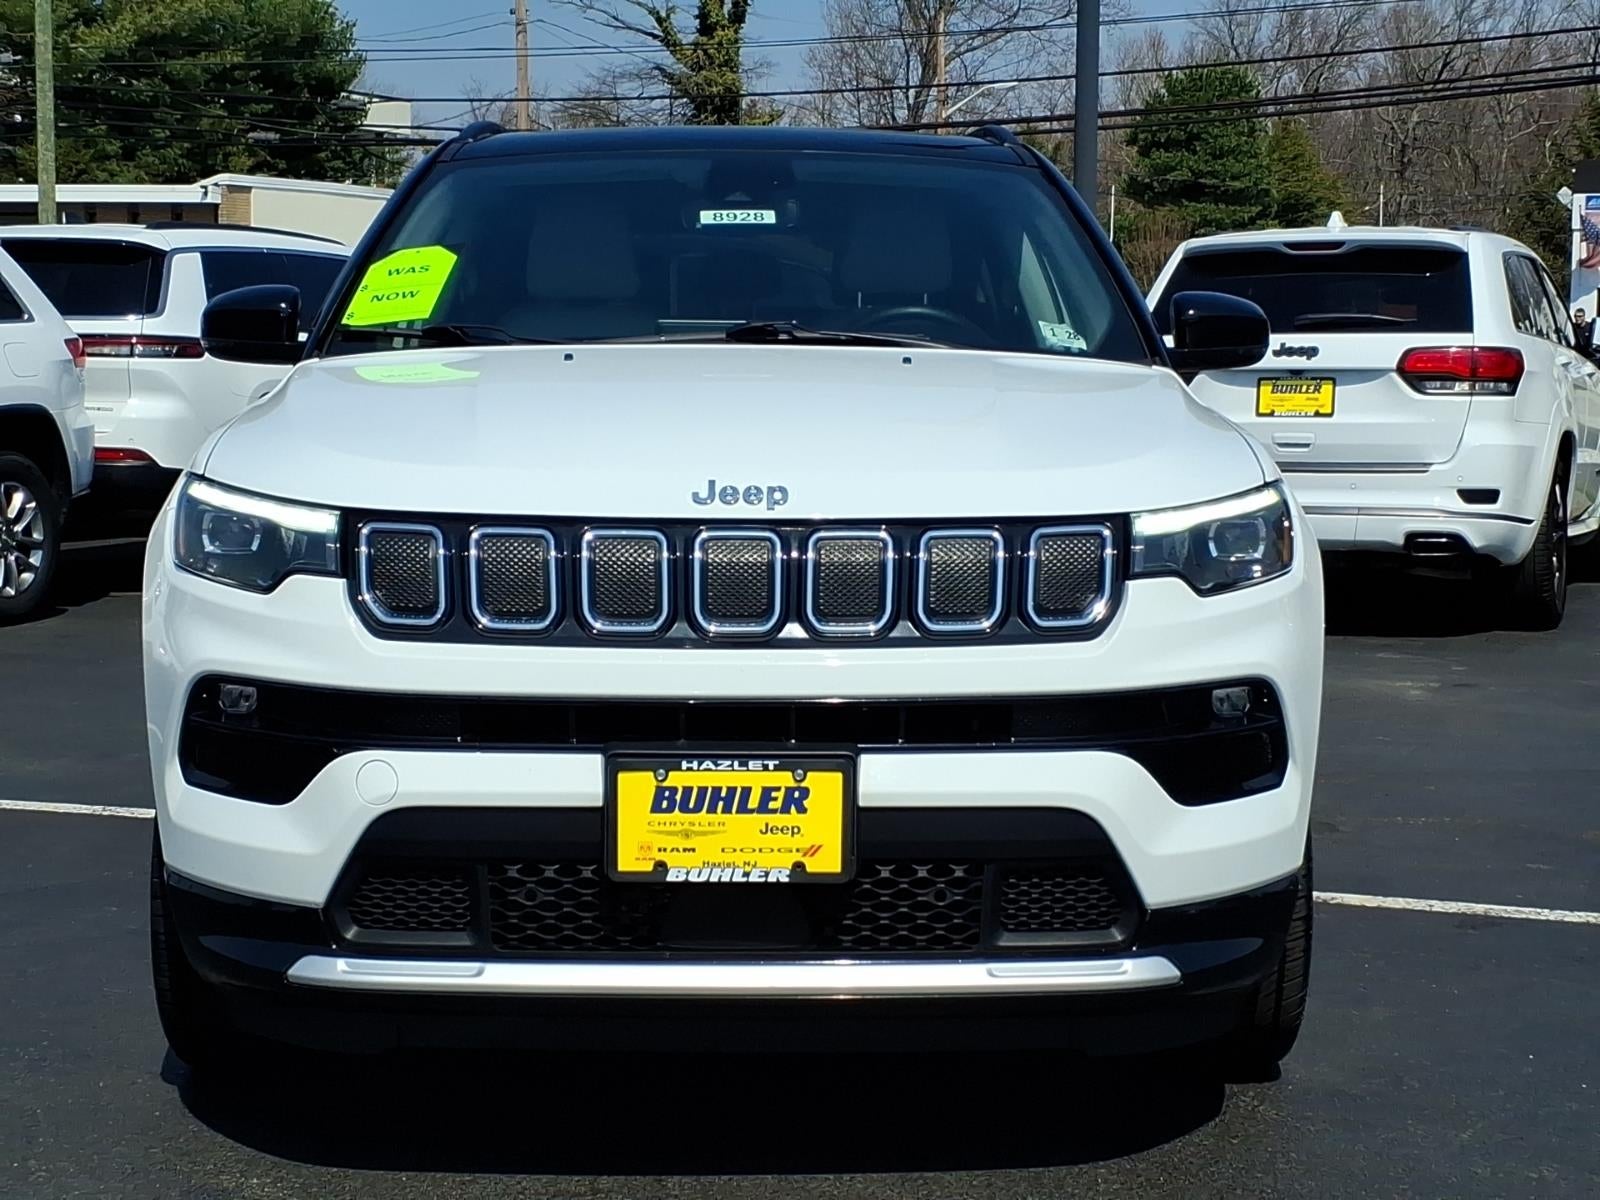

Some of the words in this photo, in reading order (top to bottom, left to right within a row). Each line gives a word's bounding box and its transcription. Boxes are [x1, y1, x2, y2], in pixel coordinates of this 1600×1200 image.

[712, 212, 765, 222] 8928
[387, 264, 431, 277] WAS
[370, 290, 420, 303] NOW
[1271, 342, 1320, 361] Jeep
[1271, 384, 1323, 394] BUHLER
[691, 479, 789, 511] Jeep
[681, 760, 779, 771] HAZLET
[650, 785, 811, 815] BUHLER
[647, 820, 726, 828] CHRYSLER
[759, 822, 801, 837] Jeep
[657, 846, 697, 854] RAM
[720, 846, 809, 854] DODGE
[665, 867, 791, 883] BUHLER
